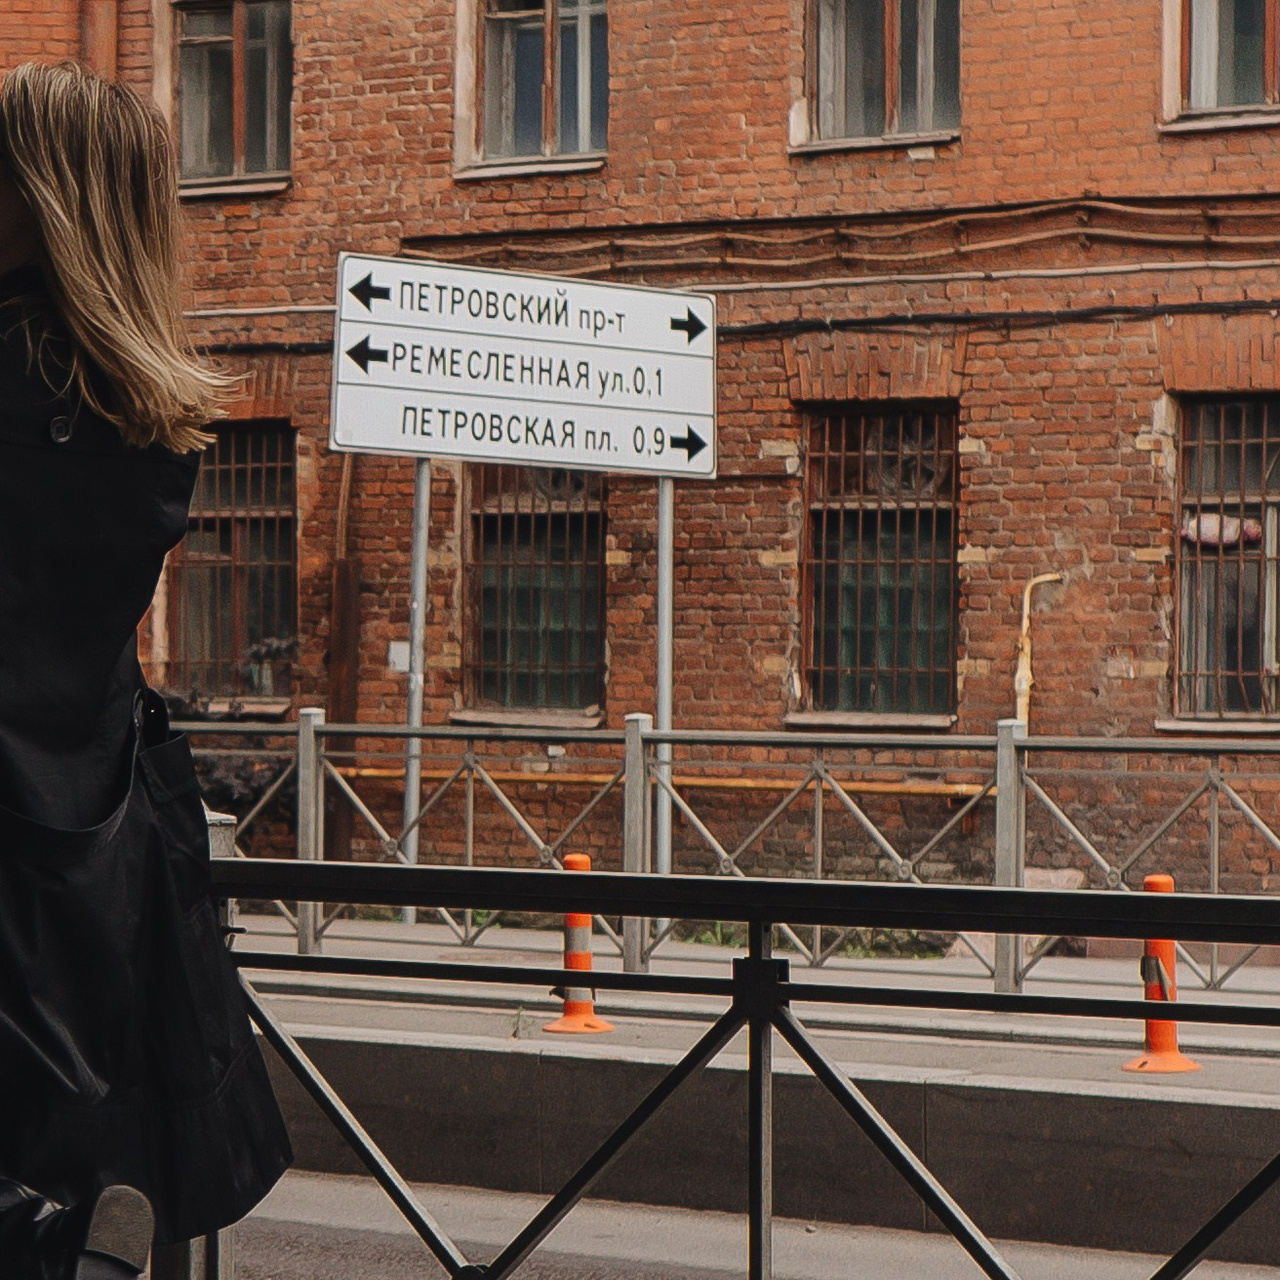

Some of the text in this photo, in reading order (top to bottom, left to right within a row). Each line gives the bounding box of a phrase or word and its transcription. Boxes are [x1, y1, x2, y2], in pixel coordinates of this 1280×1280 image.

[399, 280, 626, 338] ПЕТРОВСКИЙ пр-т
[392, 342, 589, 390] РЕМЕСЛЕННАЯ
[401, 406, 665, 456] ПЕТРОВСКАЯ пл. 0,9
